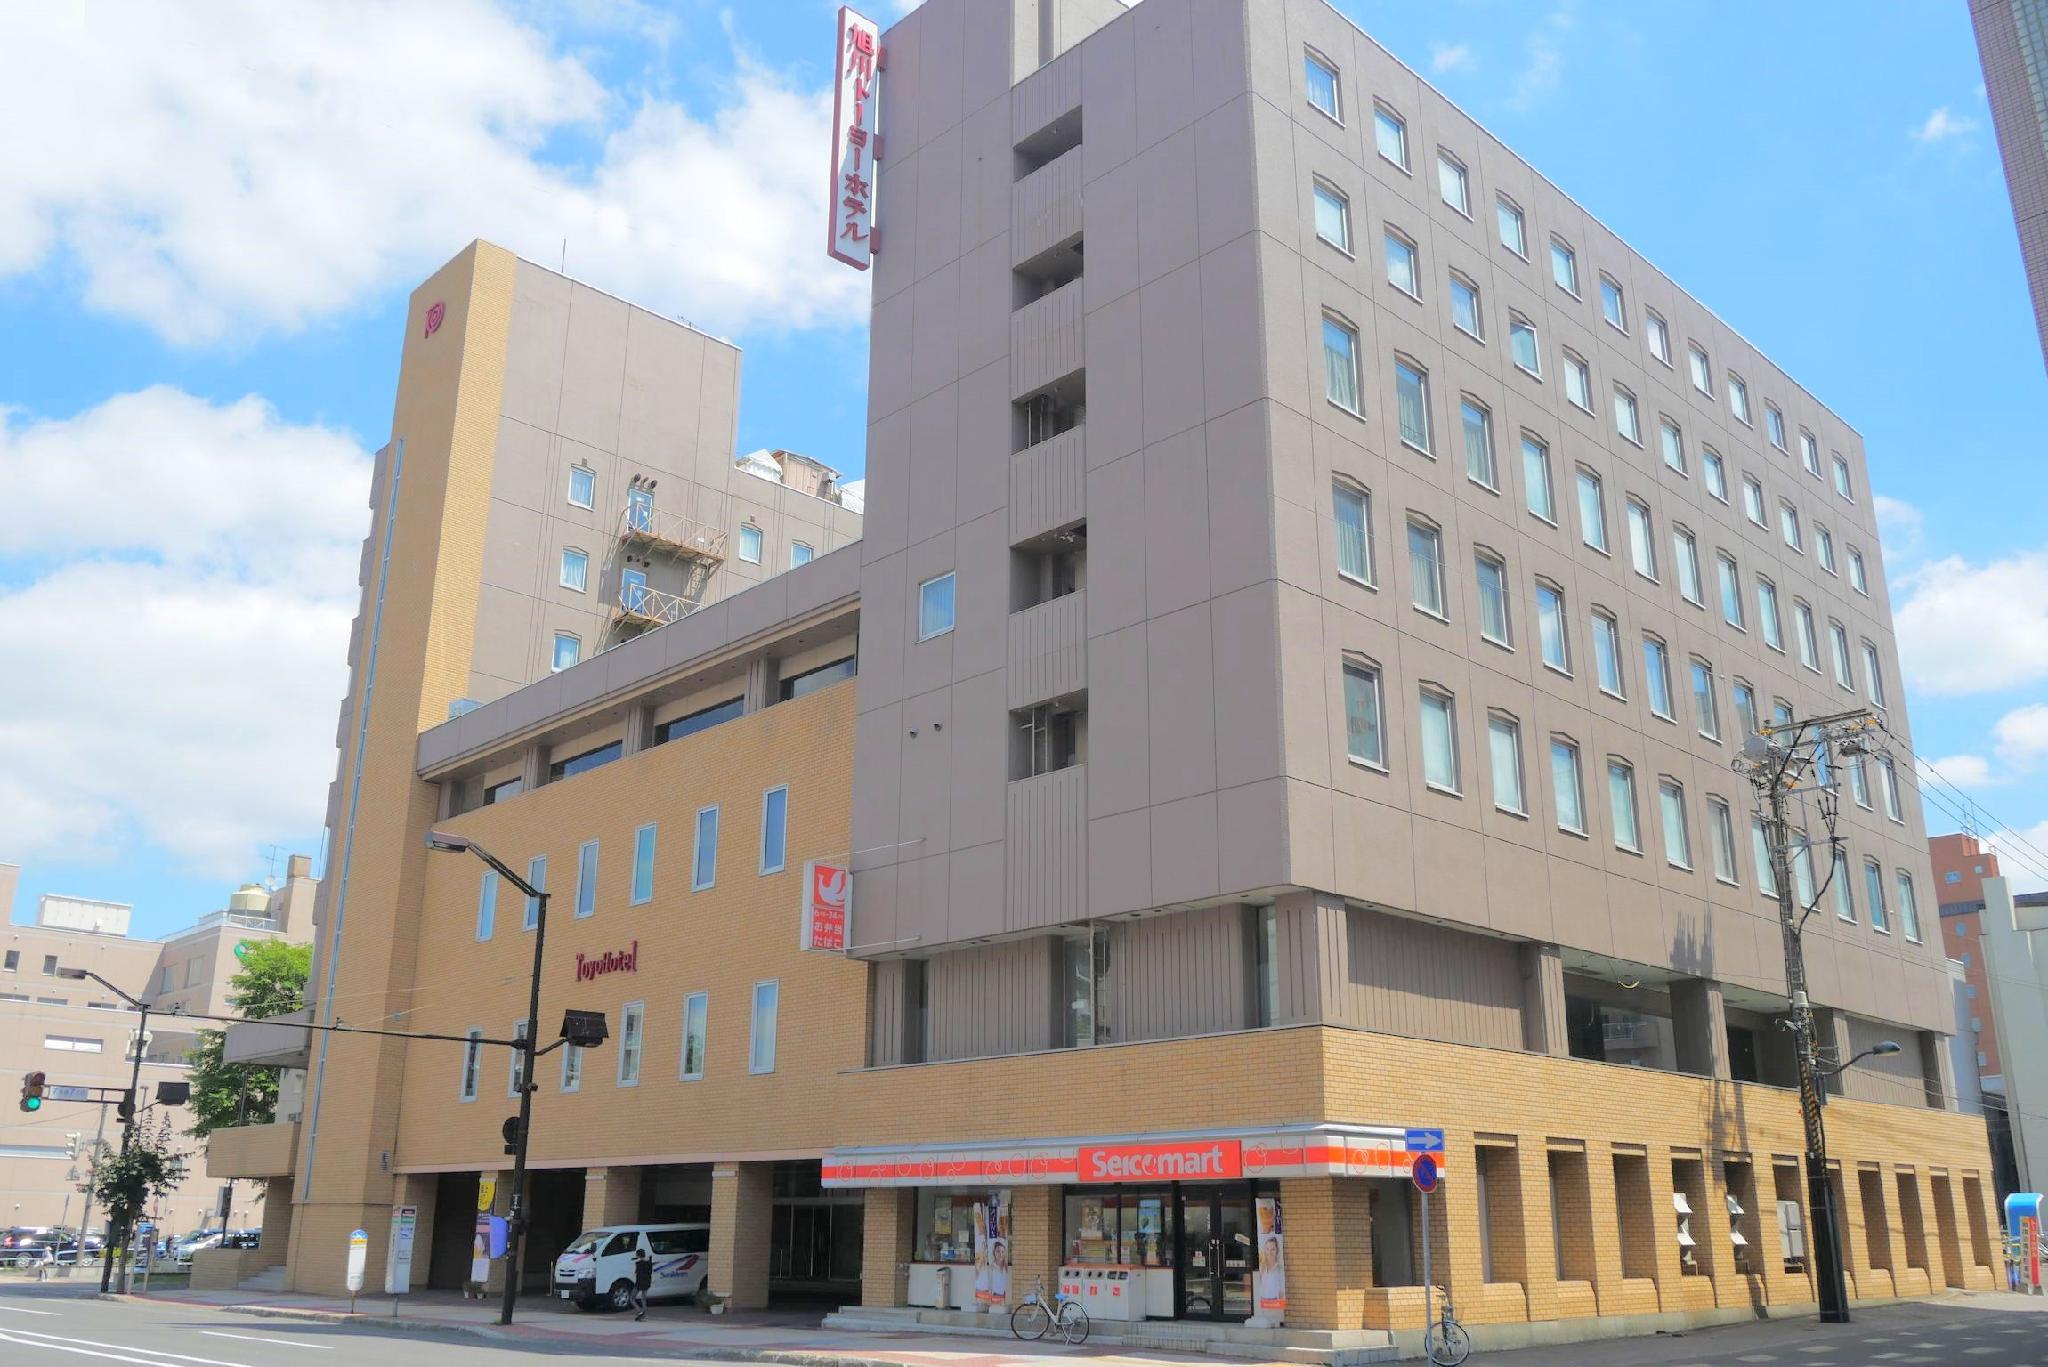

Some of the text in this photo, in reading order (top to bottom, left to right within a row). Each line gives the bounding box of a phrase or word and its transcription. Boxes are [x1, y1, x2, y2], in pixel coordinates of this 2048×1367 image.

[840, 22, 875, 243] 旭川トーヨーホテル
[1092, 1144, 1224, 1178] Seicomart
